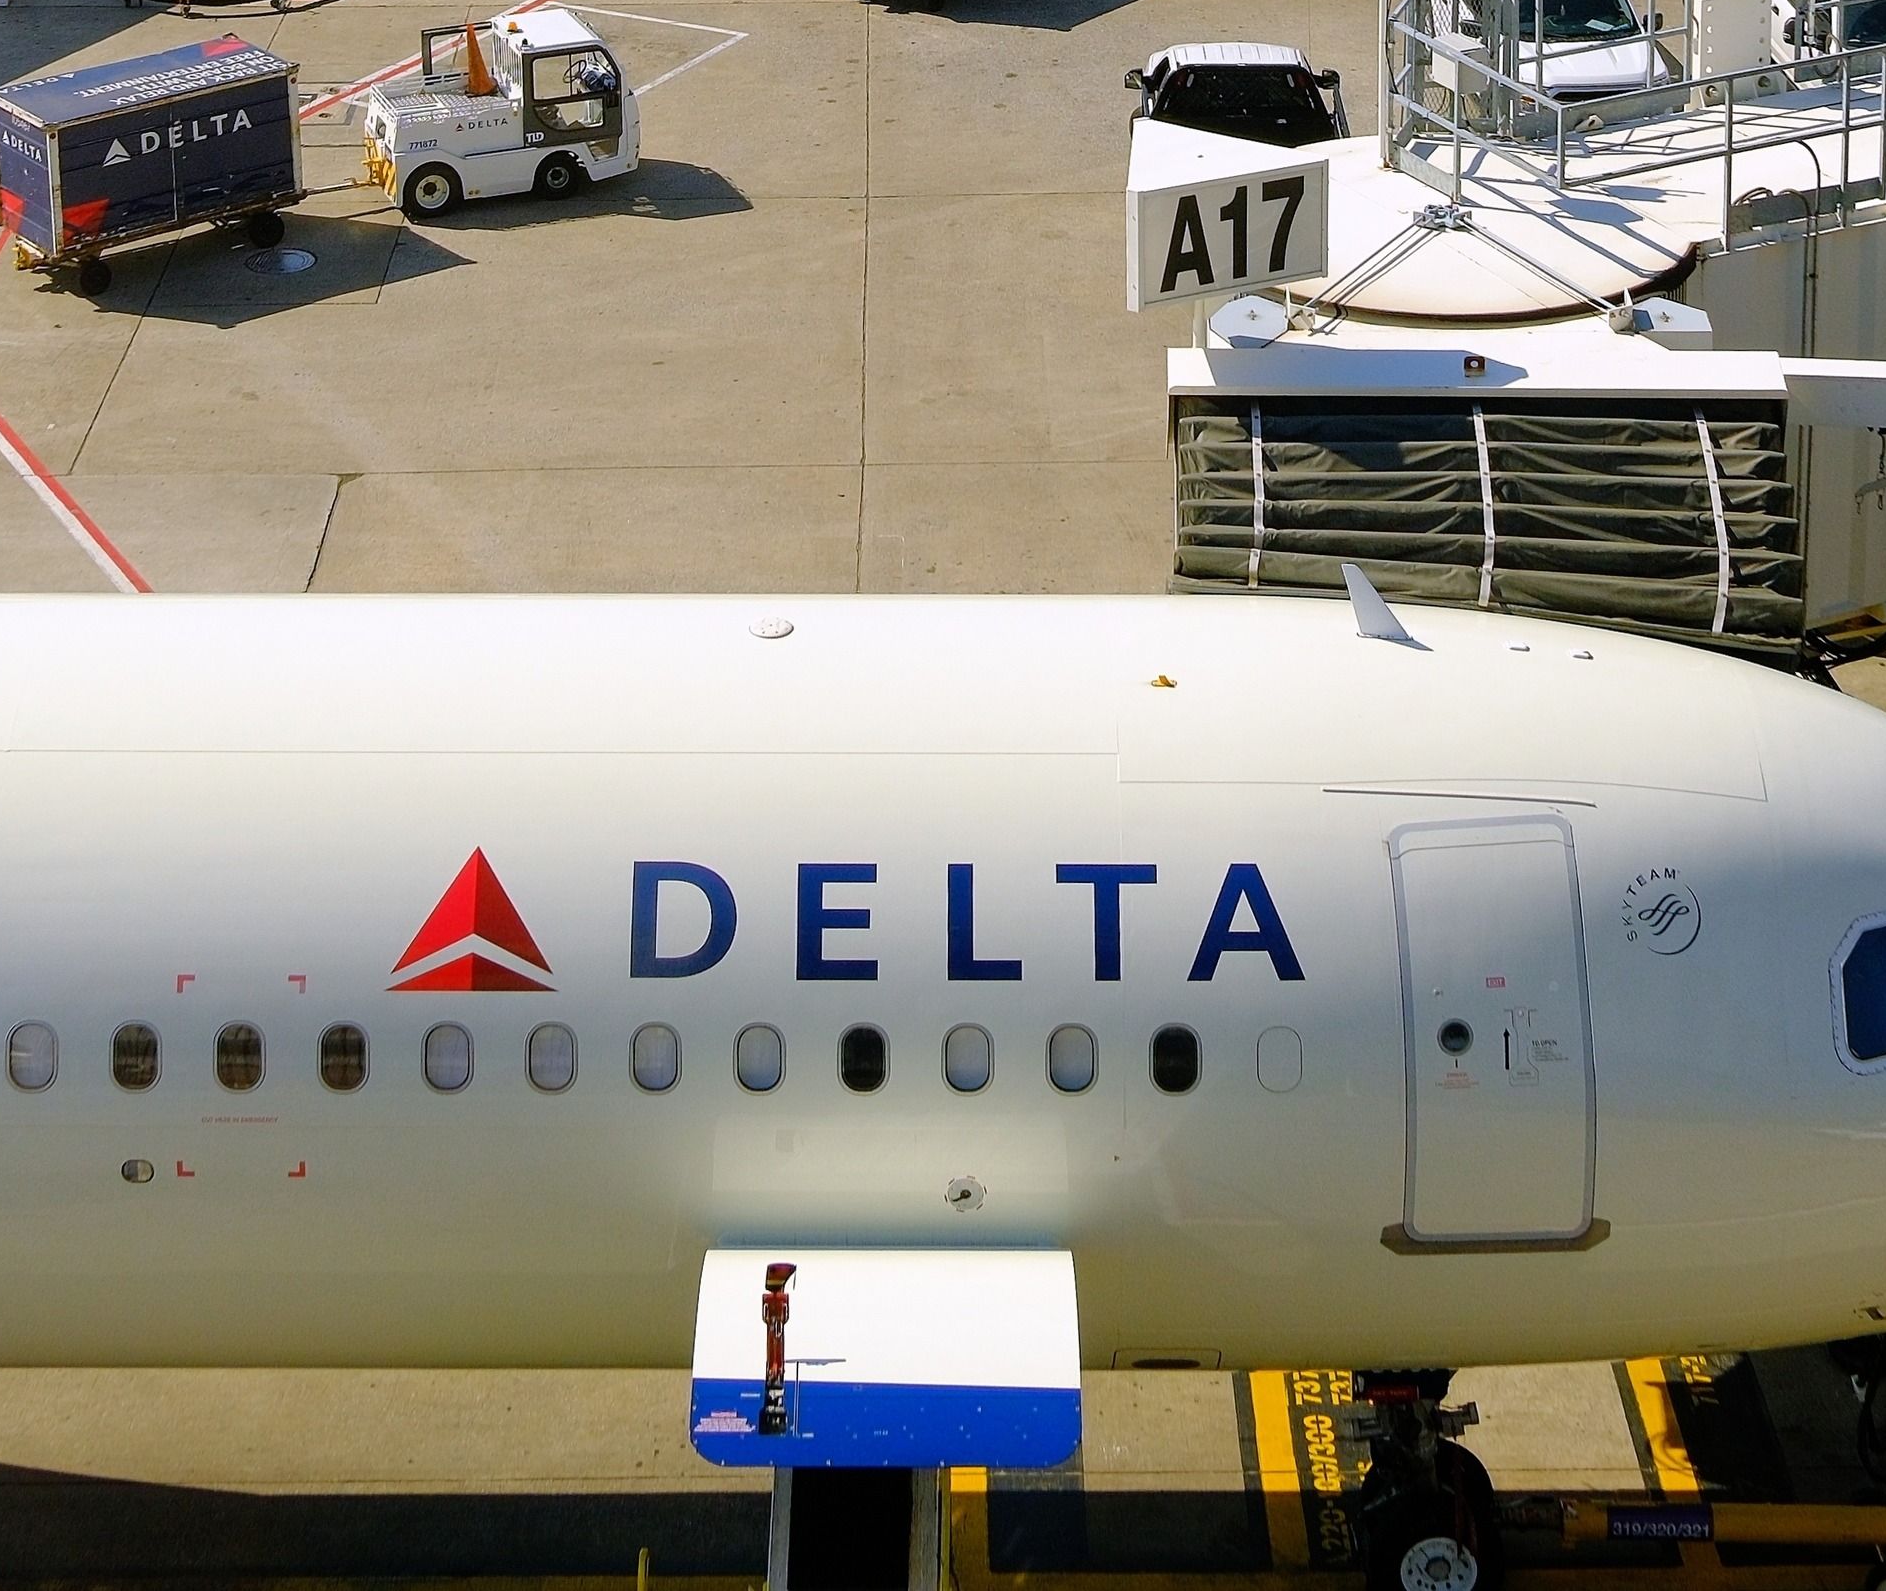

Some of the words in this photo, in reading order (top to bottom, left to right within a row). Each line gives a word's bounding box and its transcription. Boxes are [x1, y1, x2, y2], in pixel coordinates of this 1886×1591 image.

[223, 48, 266, 64] FREE
[248, 54, 276, 67] ON
[186, 60, 247, 81] BOARD
[209, 65, 257, 84] BACK
[258, 60, 289, 75] SIT
[74, 58, 223, 99] ENTERTAINMENT.
[133, 75, 185, 93] WITH
[172, 76, 211, 93] AND
[108, 83, 174, 106] RELAX
[141, 108, 252, 155] DELTA
[468, 117, 508, 130] DELTA
[409, 138, 438, 150] 771872
[526, 131, 544, 143] TLD
[11, 136, 42, 163] DELTA
[1159, 176, 1305, 293] A17
[1622, 866, 1678, 942] SKYTEAM
[630, 861, 1305, 982] DELTA
[1613, 1522, 1710, 1537] 319/320/321
